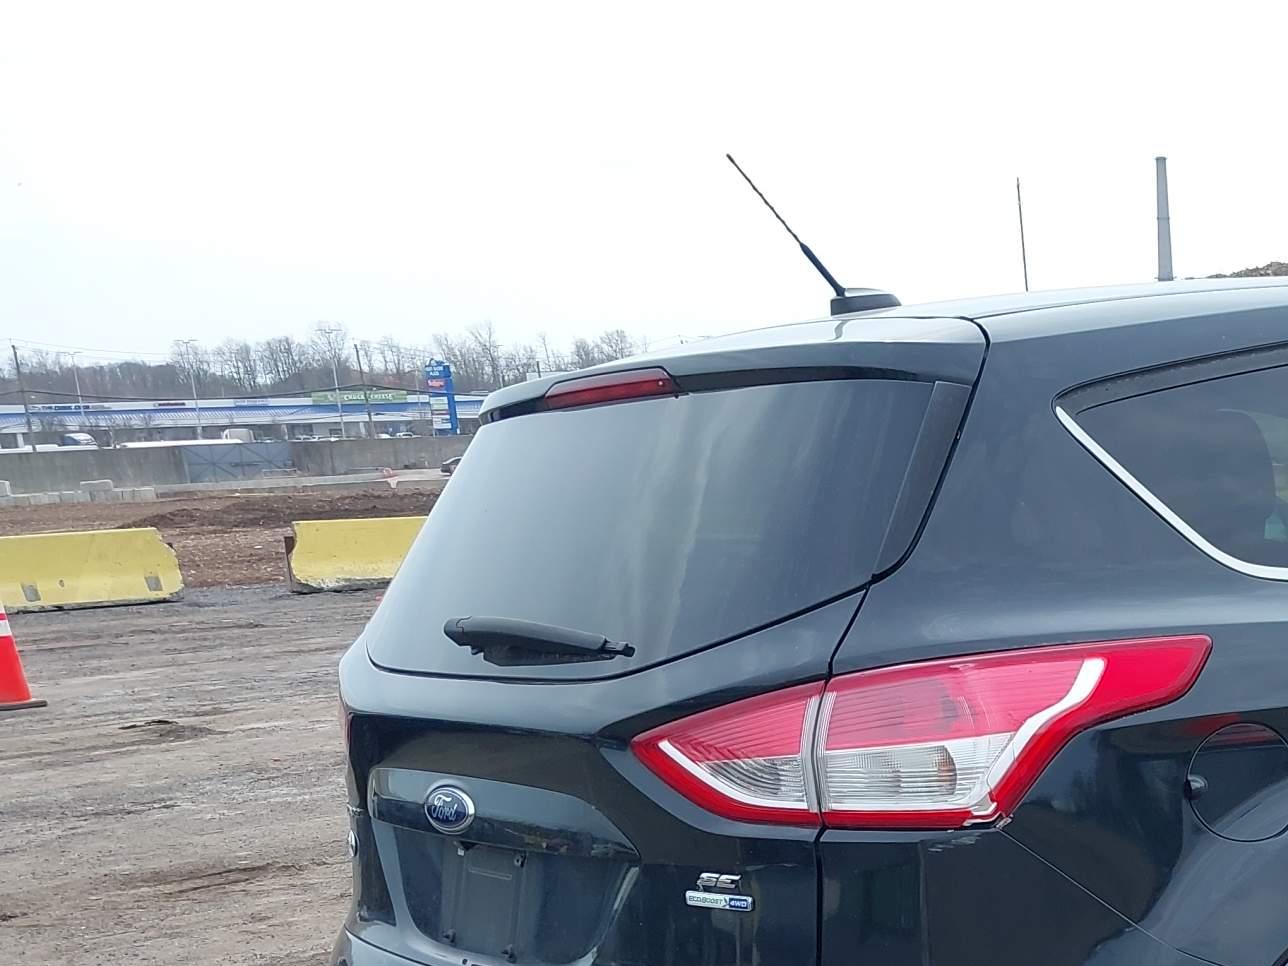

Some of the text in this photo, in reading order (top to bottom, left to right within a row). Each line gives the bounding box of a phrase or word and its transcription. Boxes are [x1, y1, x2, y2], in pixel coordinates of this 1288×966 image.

[431, 794, 458, 821] Ford
[697, 872, 742, 889] SE
[730, 900, 747, 908] 4WD
